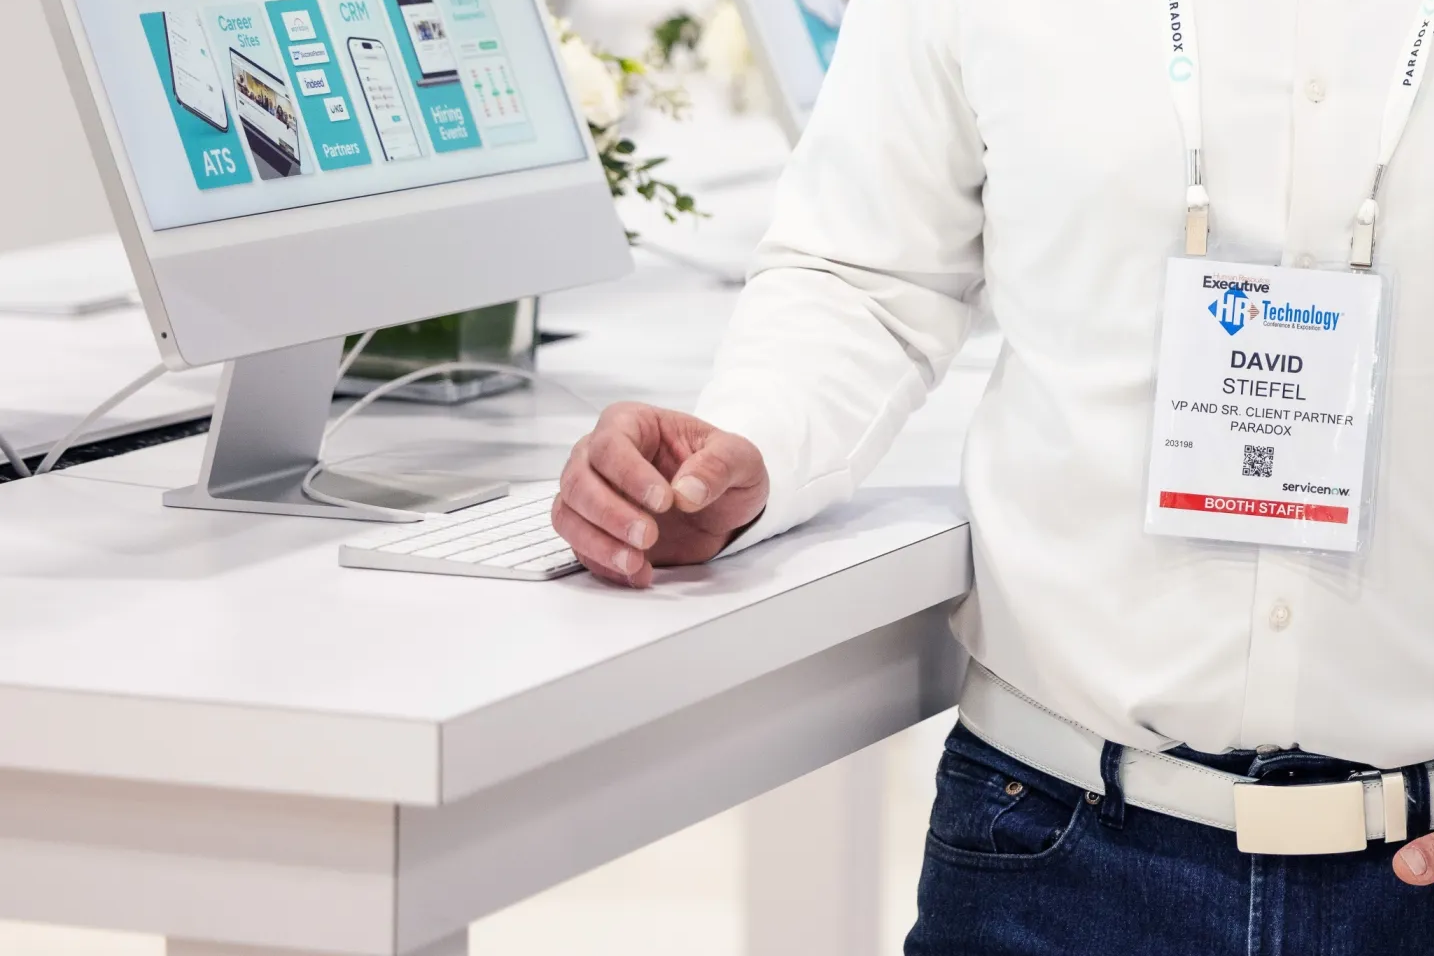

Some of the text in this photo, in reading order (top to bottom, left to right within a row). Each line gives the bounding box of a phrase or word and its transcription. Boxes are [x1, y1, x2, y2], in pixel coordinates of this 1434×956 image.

[339, 1, 371, 23] CRM
[218, 14, 253, 32] Career
[237, 33, 261, 48] Sites
[1402, 18, 1431, 87] PARADOX
[304, 77, 325, 90] indeed
[430, 104, 465, 125] Hiring
[439, 125, 469, 141] Events
[322, 142, 360, 158] Partners
[203, 147, 237, 177] ATS
[1202, 275, 1270, 294] Executive
[1217, 293, 1340, 331] HR Technology
[1263, 320, 1291, 329] Conference
[1296, 324, 1322, 332] Exposition
[1230, 350, 1304, 374] DAVID
[1222, 377, 1307, 401] STIEFEL
[1171, 400, 1354, 426] VP AND SR. CLIENT PARTNER
[1230, 421, 1292, 436] PARADOX
[1165, 439, 1193, 449] 203198
[1282, 482, 1350, 497] servicenow
[1204, 497, 1304, 519] BOOTH STAFF
